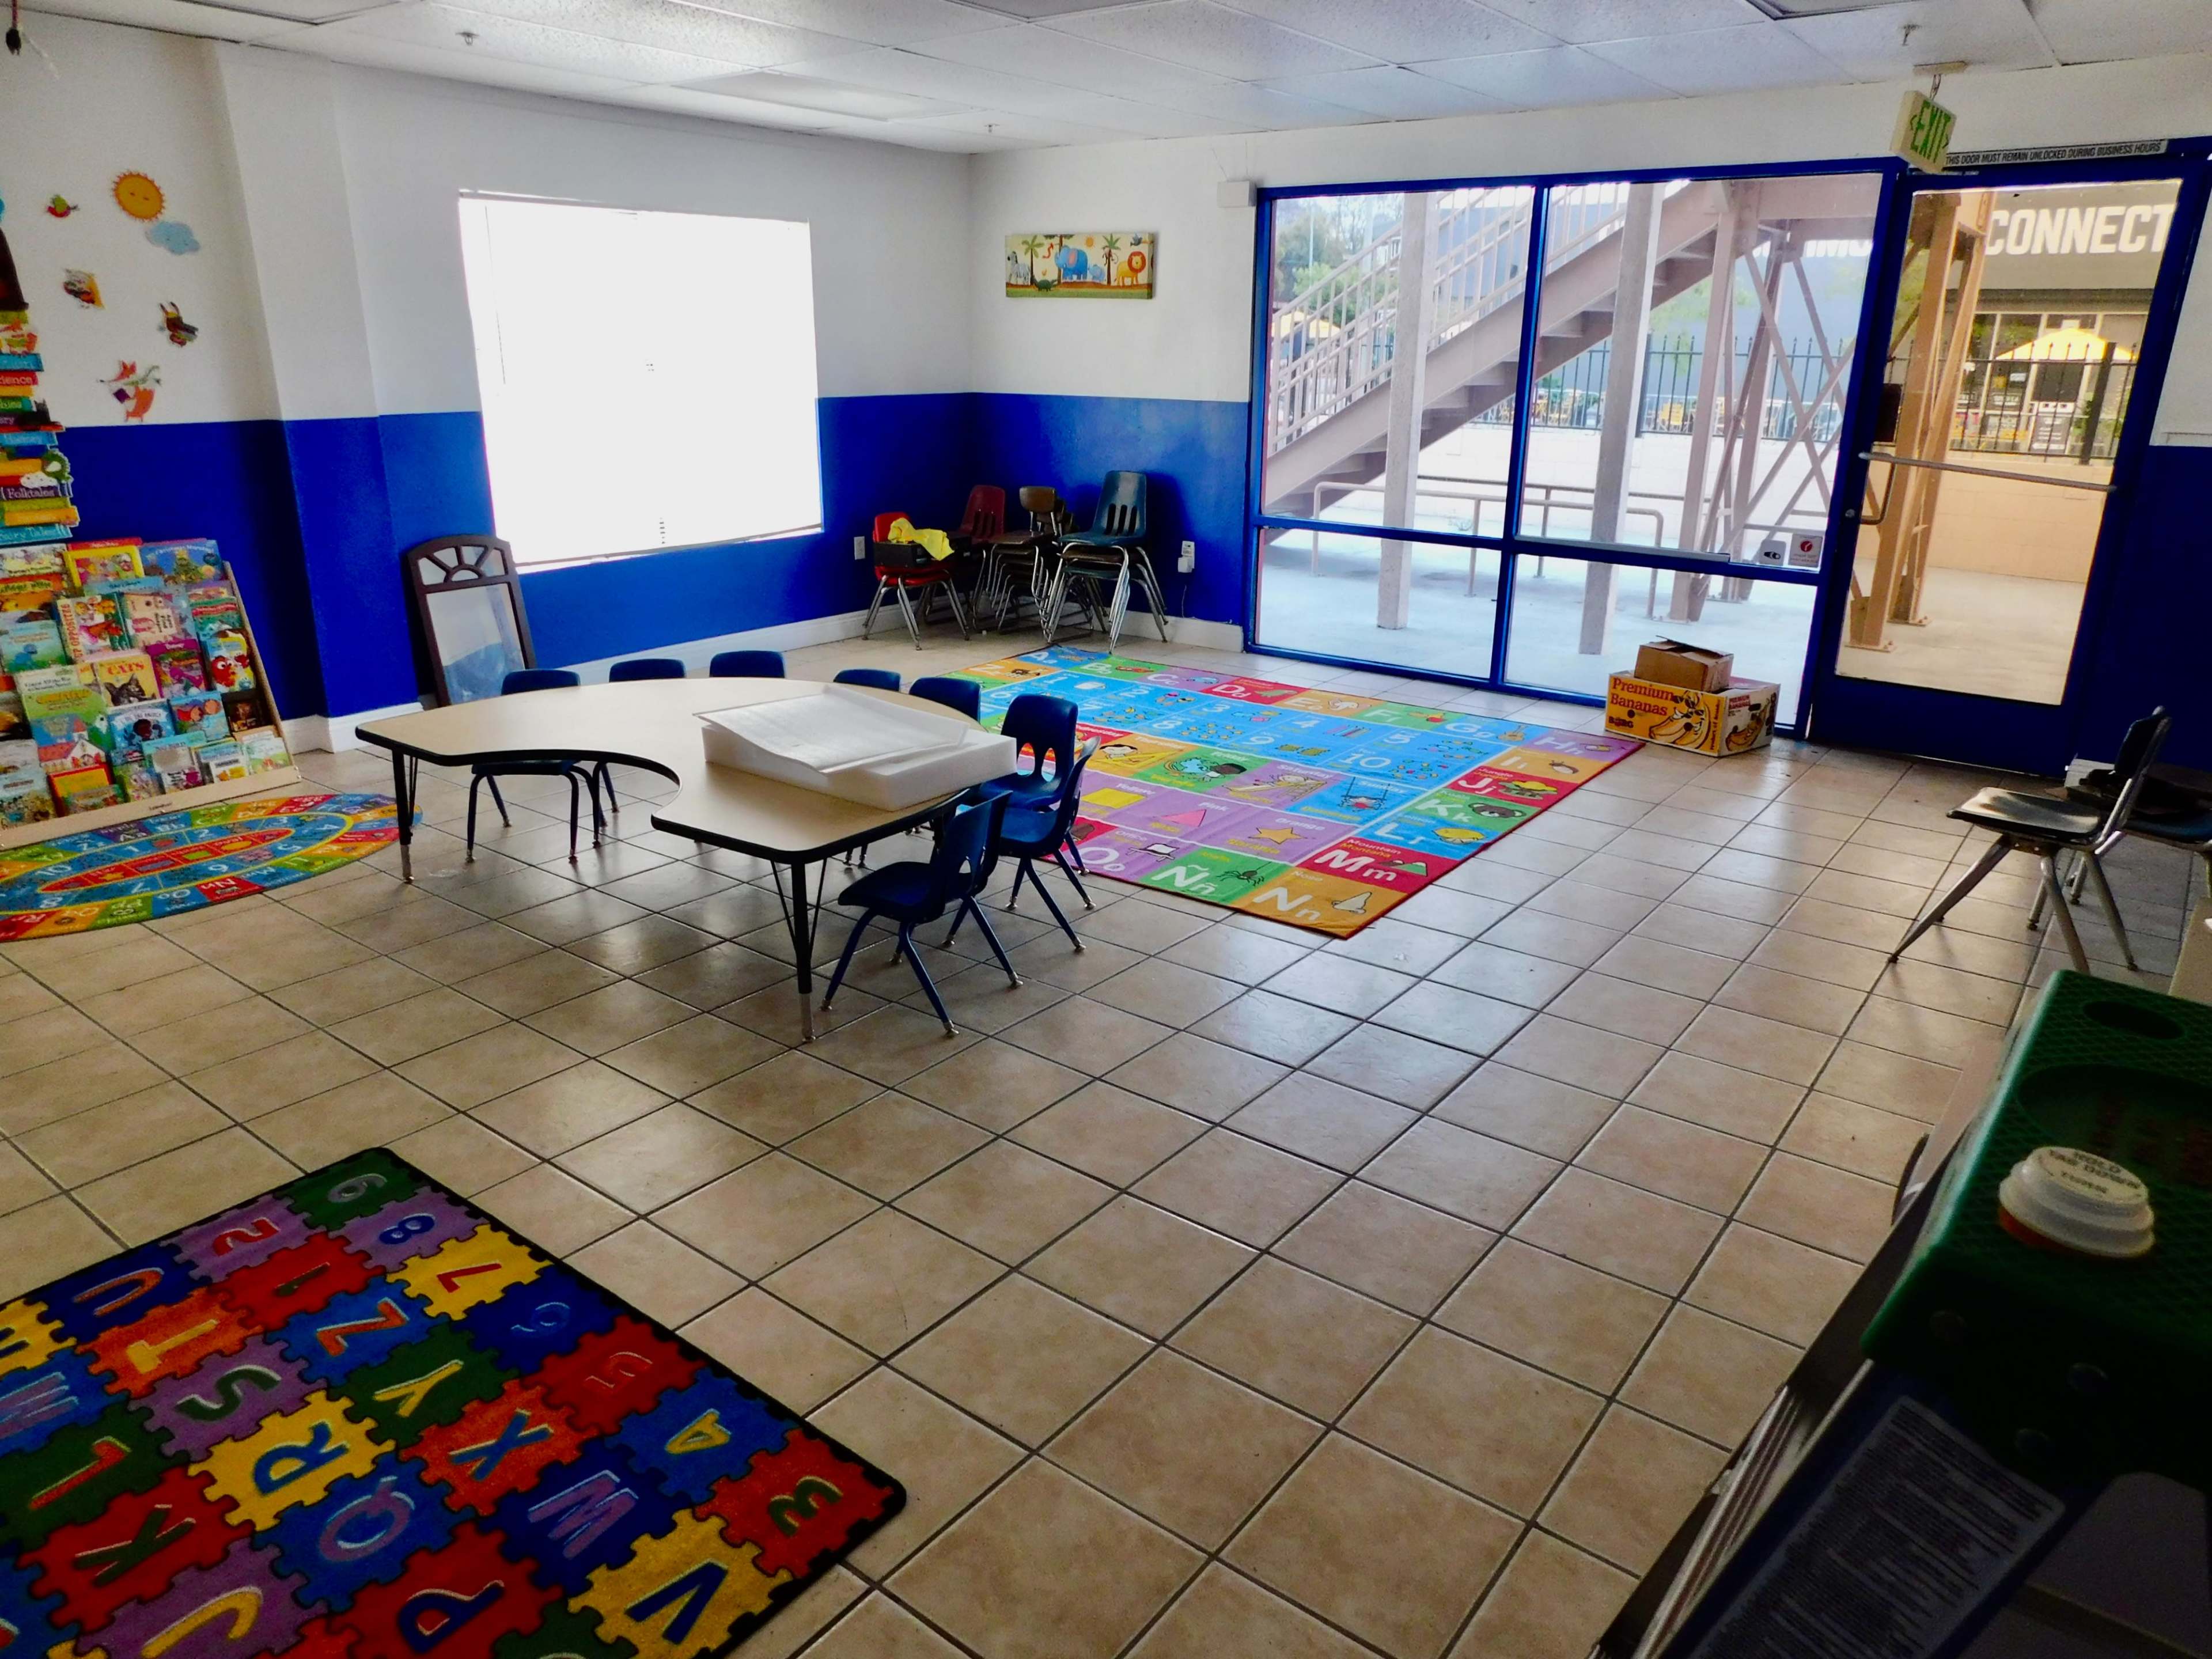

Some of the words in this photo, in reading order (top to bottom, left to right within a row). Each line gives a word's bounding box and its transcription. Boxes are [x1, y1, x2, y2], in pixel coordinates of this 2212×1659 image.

[1910, 100, 1951, 163] EXIT
[1946, 156, 1960, 165] THIS
[1961, 155, 1980, 164] DOOR
[1982, 153, 2002, 162] MUST
[2002, 151, 2028, 162] REMAIN
[2029, 149, 2067, 161] UNLOCKED
[2067, 147, 2096, 158] DURING
[2097, 144, 2133, 156] BUSINESS
[2134, 142, 2161, 153] HOURS
[1985, 203, 2175, 256] CONNECT
[7, 487, 55, 499] Folktales
[1213, 684, 1251, 698] Dd
[1611, 692, 1668, 716] Bananas
[1612, 677, 1675, 701] Premium
[1341, 752, 1391, 768] 10
[1275, 817, 1325, 831] Orange
[1348, 839, 1402, 855] Mountain
[1152, 865, 1217, 895] Ññ
[1314, 849, 1397, 881] Mm
[1252, 887, 1321, 921] Nn
[213, 1218, 281, 1257] 2
[379, 1212, 436, 1245] 8
[73, 1266, 164, 1317] U
[436, 1262, 502, 1294] 7
[126, 1319, 219, 1374] T
[315, 1296, 410, 1358] Z
[173, 1363, 282, 1423] S
[372, 1358, 464, 1417] Y
[448, 1407, 555, 1481] X
[664, 1407, 732, 1455] 4
[29, 1434, 131, 1510] L
[252, 1419, 350, 1497] R
[319, 1476, 416, 1564] Q
[527, 1469, 640, 1560] W
[767, 1475, 844, 1537] 3
[74, 1503, 196, 1588] K
[139, 1584, 264, 1659] J
[397, 1579, 505, 1654] P
[623, 1558, 730, 1646] V
